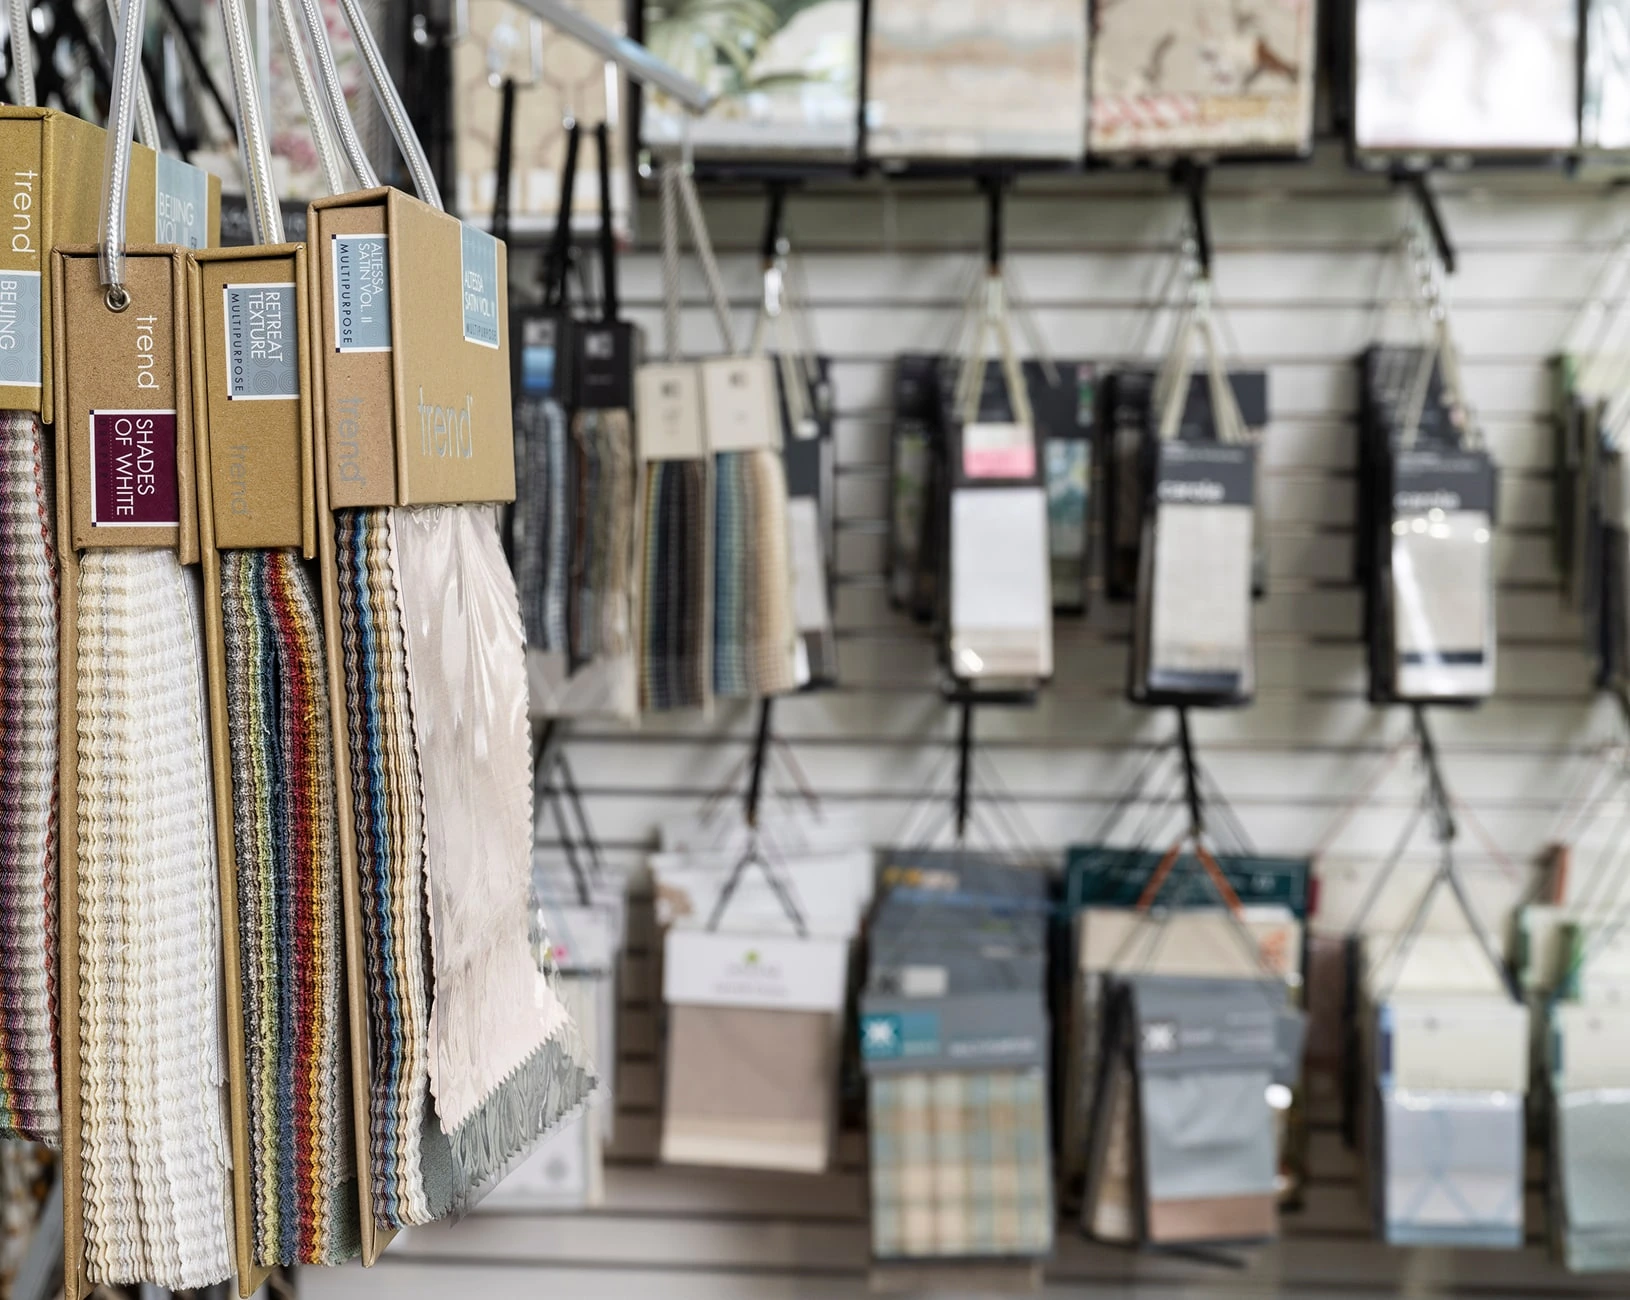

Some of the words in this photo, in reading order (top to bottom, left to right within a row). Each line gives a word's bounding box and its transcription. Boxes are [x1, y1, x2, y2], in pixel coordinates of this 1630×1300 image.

[12, 169, 38, 253] trend
[159, 191, 194, 227] BEIJING
[340, 243, 353, 343] MULTIPURPOSE
[359, 243, 371, 280] SATIN
[371, 242, 384, 295] ALTESSA
[463, 270, 484, 293] ALTESSA
[0, 280, 17, 351] BEIJING
[248, 291, 265, 359] TEXTURE
[265, 291, 283, 361] RETREAT
[360, 284, 372, 312] VOL.
[136, 314, 159, 390] trend
[231, 293, 244, 391] MULTIPURPOSE
[115, 418, 132, 446] OF
[136, 418, 155, 495] SHADES
[337, 396, 364, 483] trend
[418, 385, 473, 459] trend
[116, 453, 134, 516] WHITE
[230, 444, 250, 516] trend
